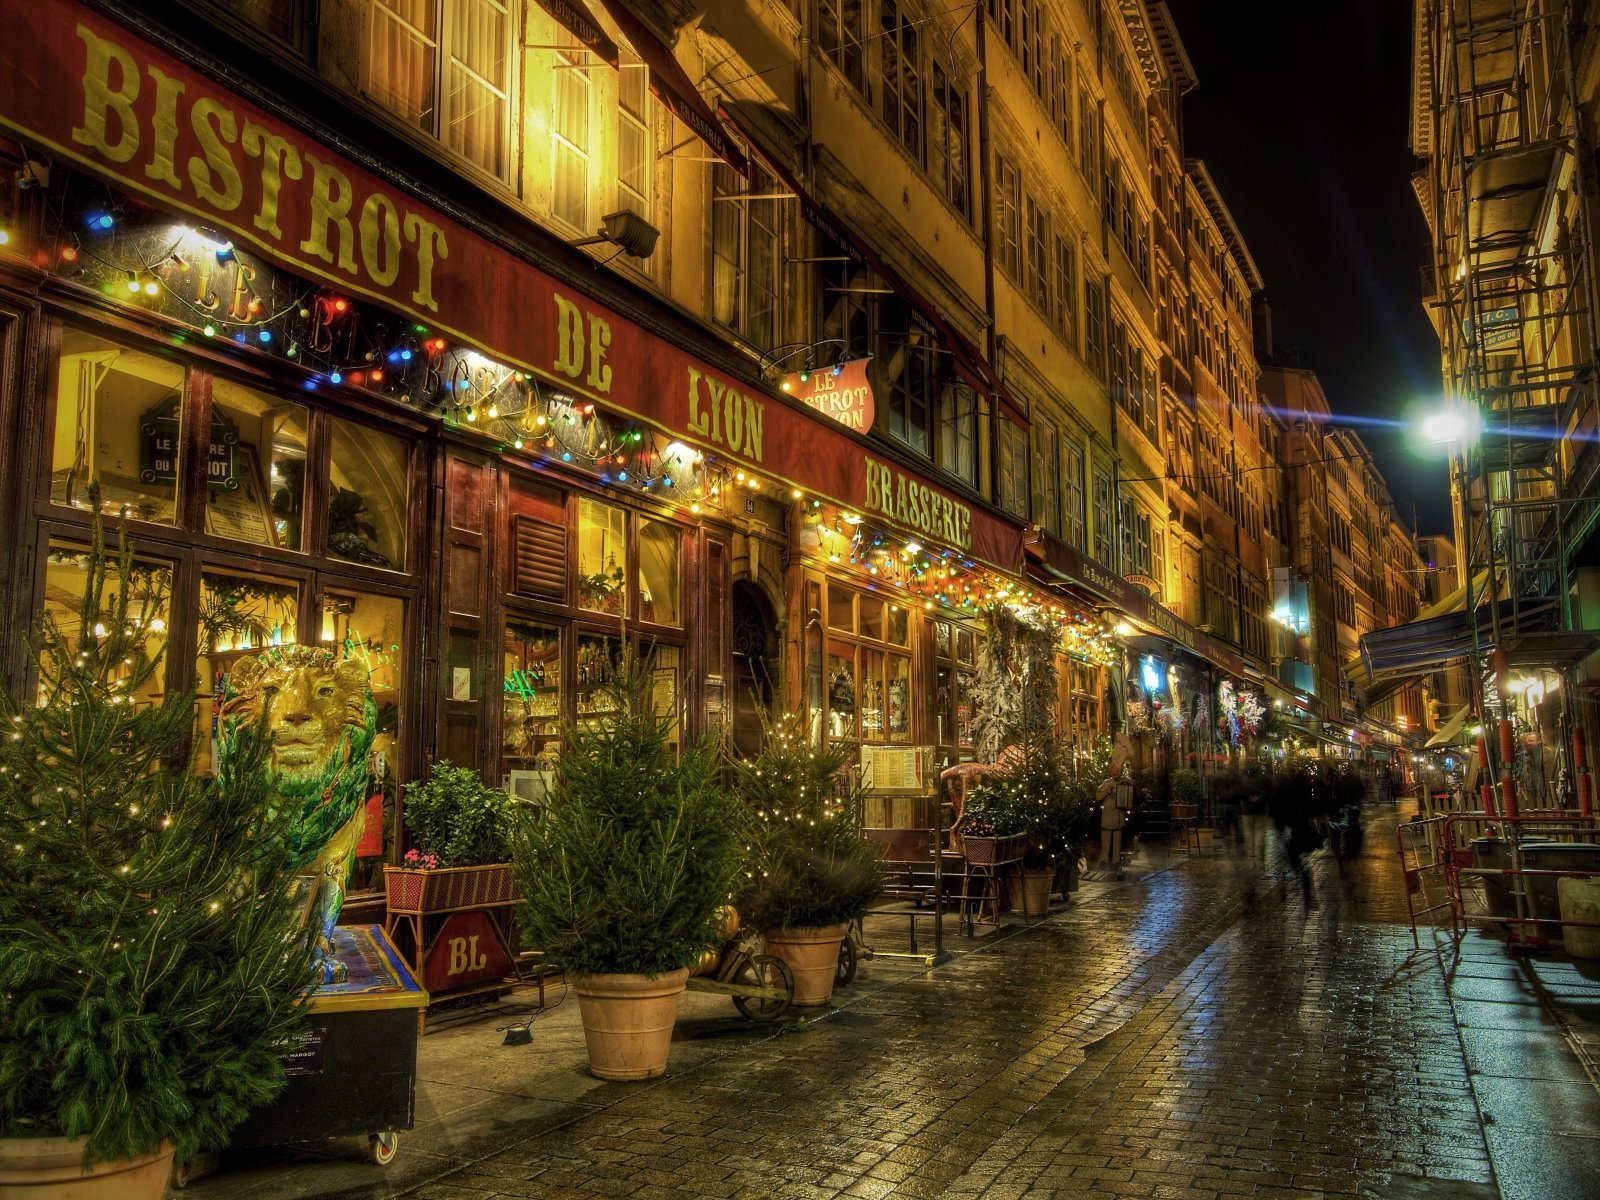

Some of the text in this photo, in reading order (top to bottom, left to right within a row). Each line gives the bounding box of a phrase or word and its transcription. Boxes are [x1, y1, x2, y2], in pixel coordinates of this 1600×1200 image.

[680, 101, 721, 150] BRASSERIE
[71, 22, 972, 550] BISTROT DE LYON BRASSERIE
[194, 244, 256, 323] LE
[814, 371, 836, 393] LE
[156, 438, 171, 451] LE
[155, 459, 170, 472] DU
[447, 935, 487, 976] BL
